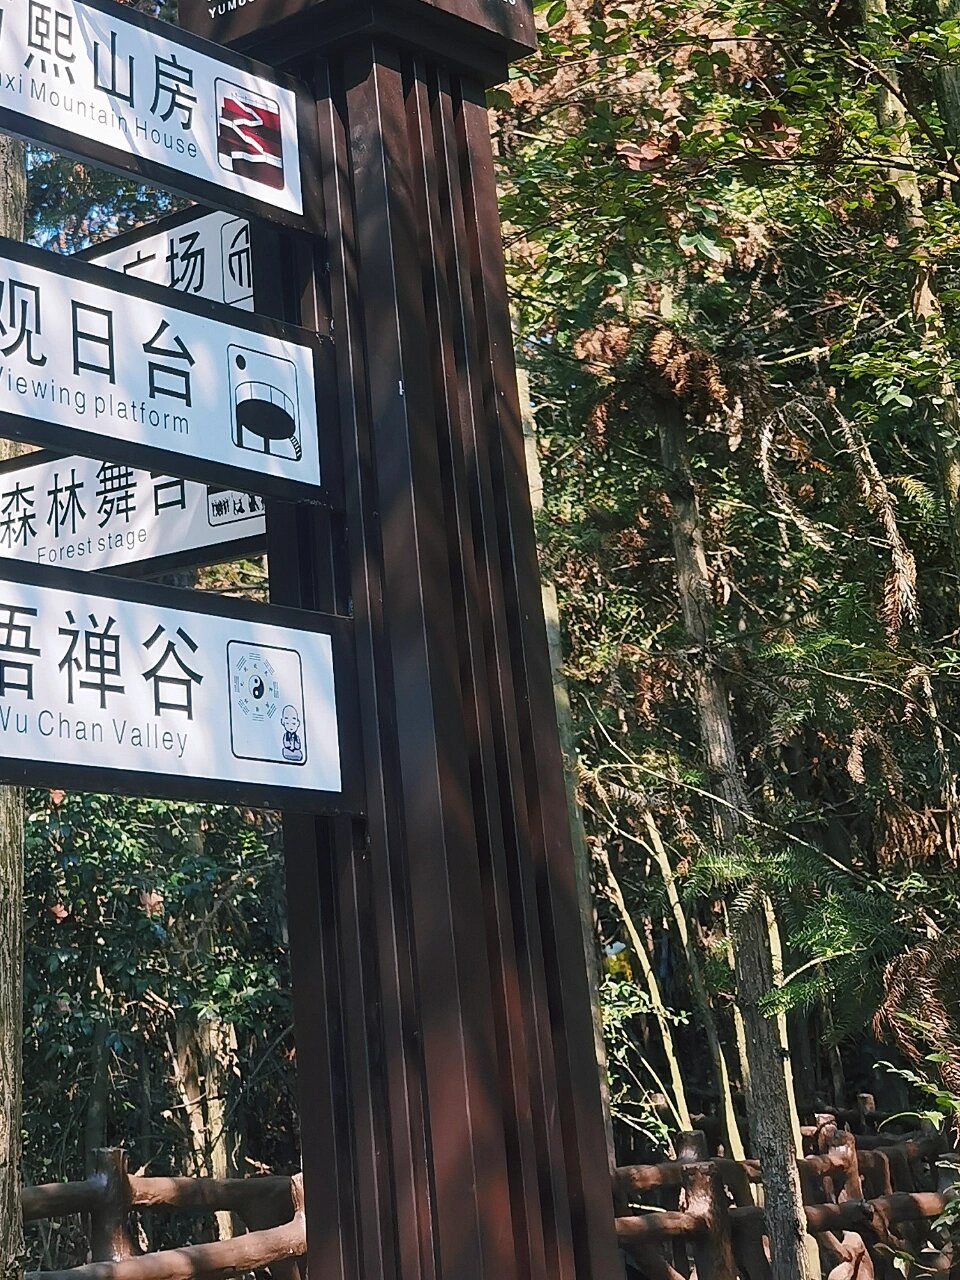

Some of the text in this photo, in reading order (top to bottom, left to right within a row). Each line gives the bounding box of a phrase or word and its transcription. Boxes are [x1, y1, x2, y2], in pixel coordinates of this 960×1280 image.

[30, 77, 129, 136] Mountain
[135, 118, 199, 159] House
[94, 396, 190, 435] platform
[37, 527, 147, 564] Forest stage
[38, 710, 104, 745] Chan
[112, 718, 189, 759] Valley
